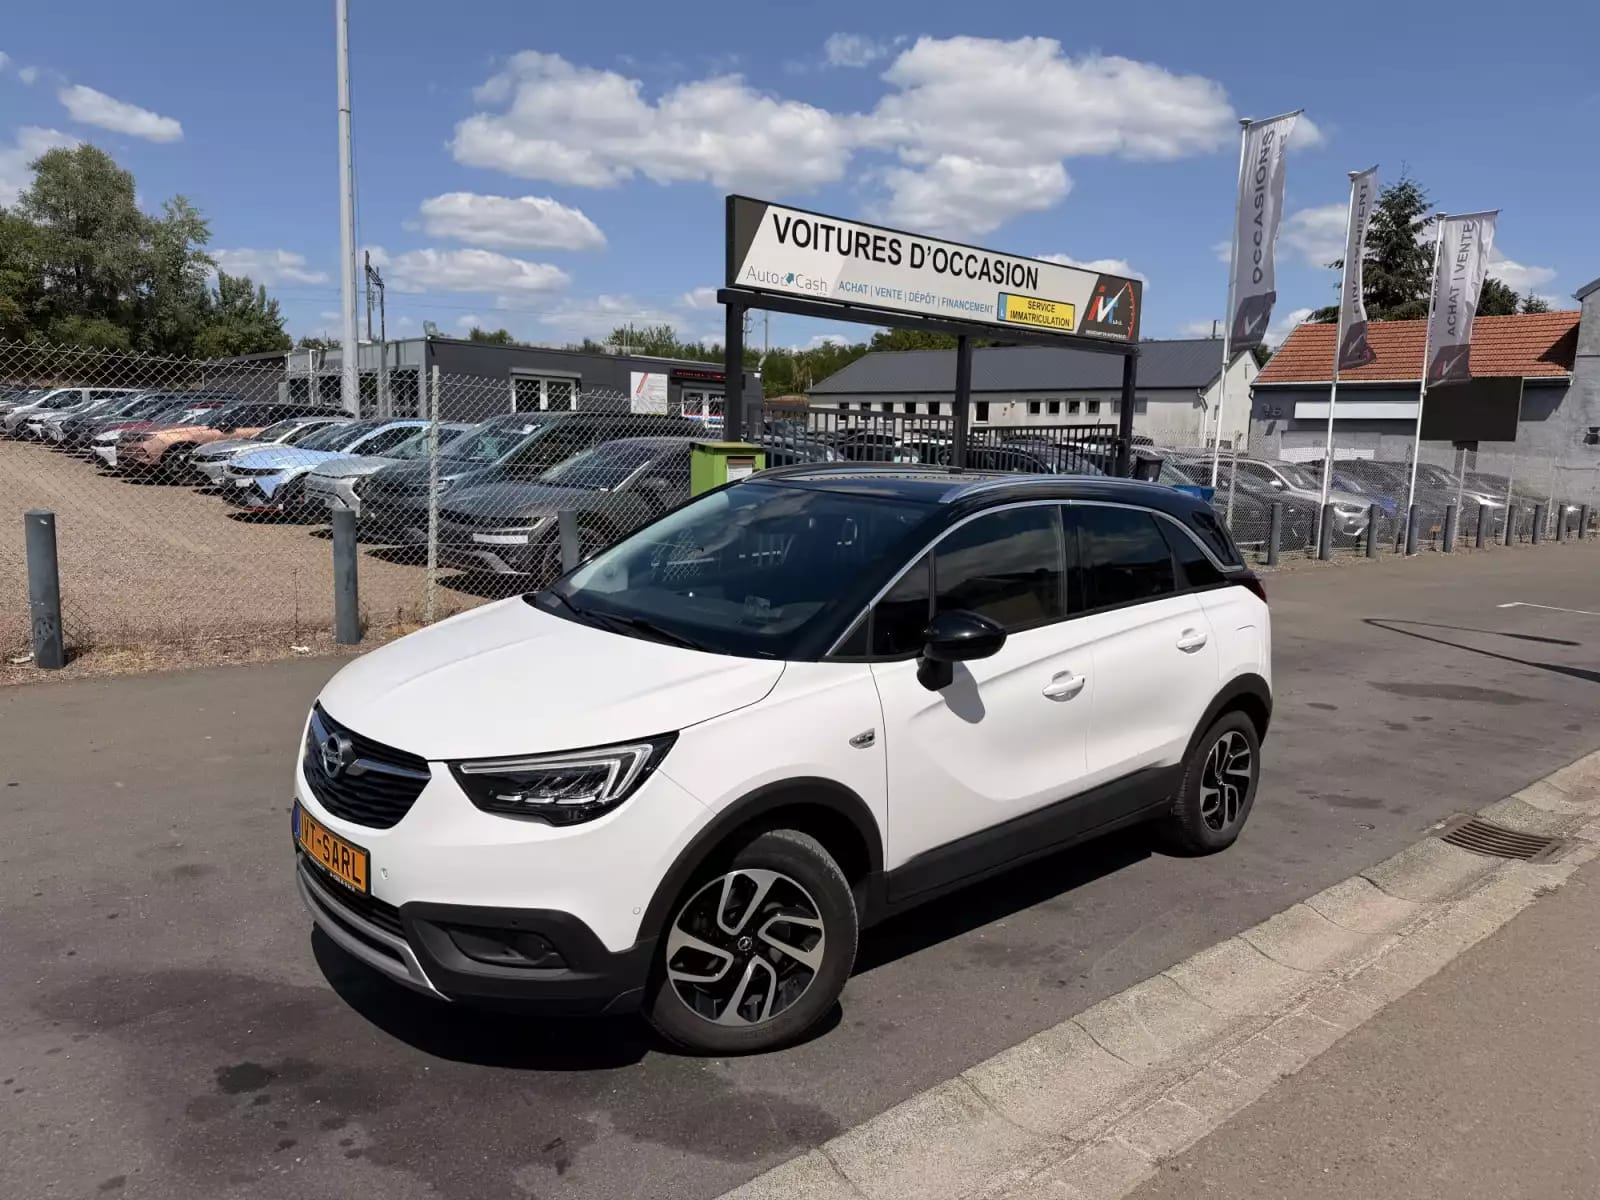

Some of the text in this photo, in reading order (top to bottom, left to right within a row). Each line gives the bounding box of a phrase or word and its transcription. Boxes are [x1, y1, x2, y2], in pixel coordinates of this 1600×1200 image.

[1252, 130, 1275, 284] OCCASIONS
[773, 213, 1038, 290] VOITURES D'OCCASION
[746, 265, 828, 292] Auto Cash
[1447, 287, 1461, 336] ACHAT
[1457, 220, 1475, 274] VENTE
[838, 280, 994, 314] ACHAT VENTE DÉPÔT FINANCEMENT
[1027, 300, 1056, 313] SERVICE
[1010, 310, 1070, 327] IMMATRICULATION
